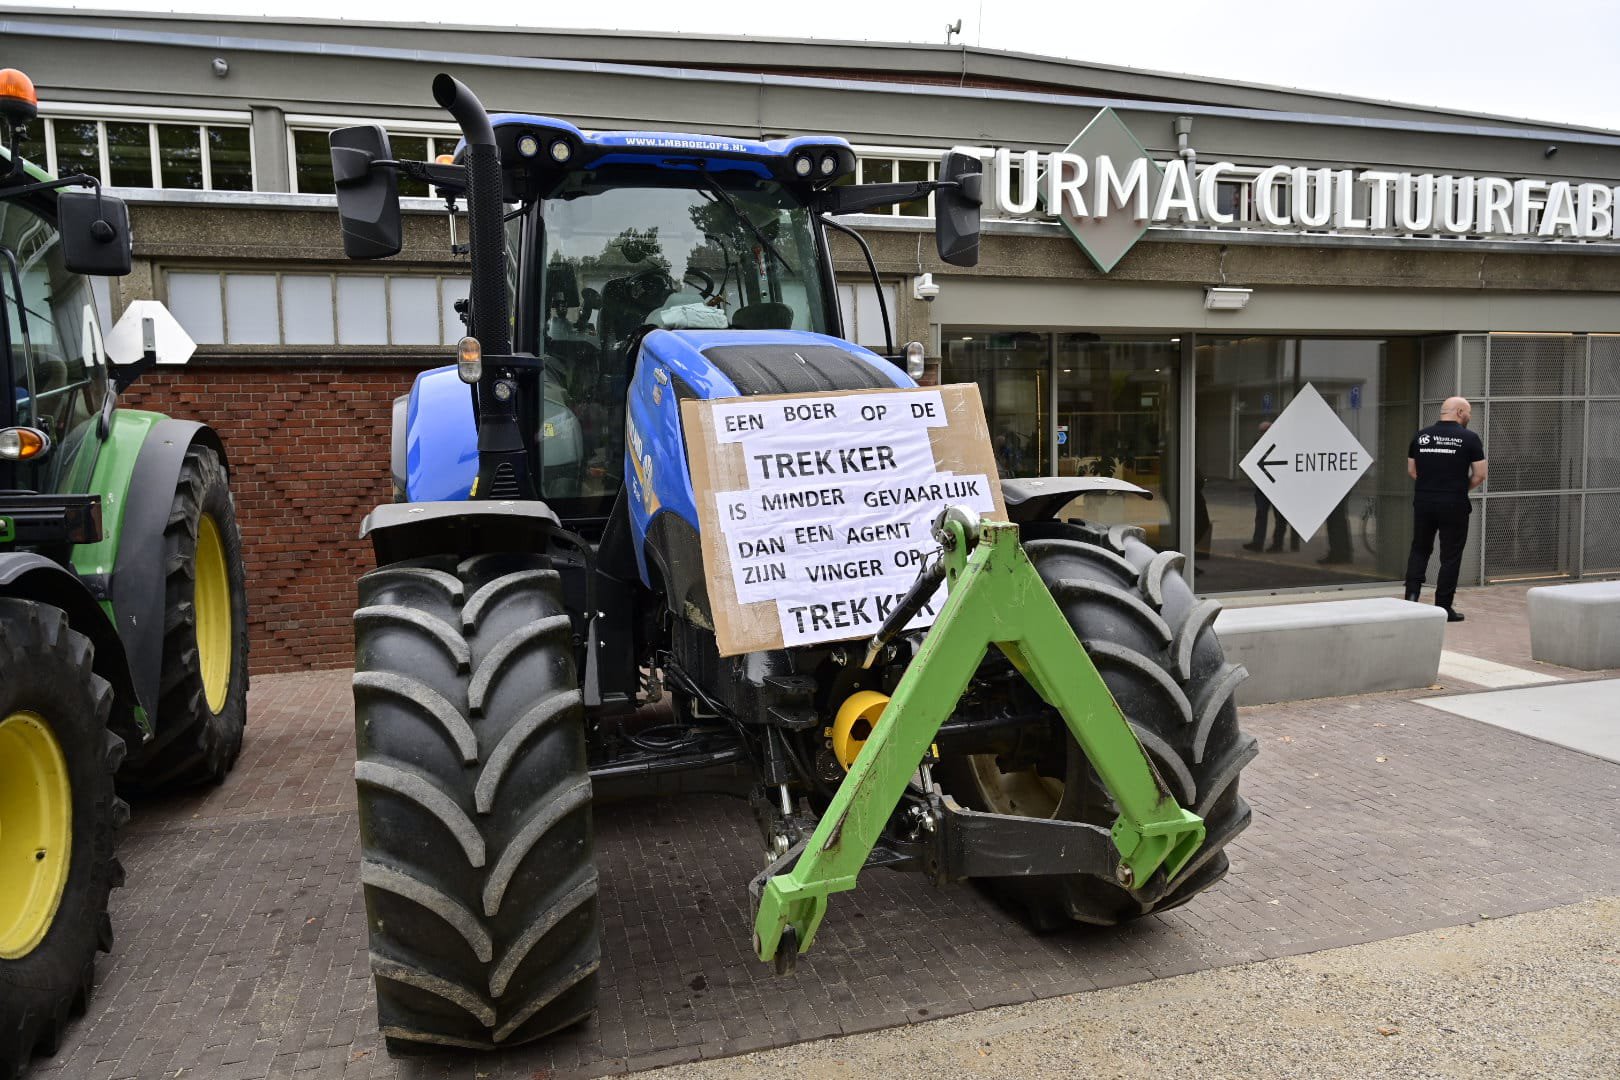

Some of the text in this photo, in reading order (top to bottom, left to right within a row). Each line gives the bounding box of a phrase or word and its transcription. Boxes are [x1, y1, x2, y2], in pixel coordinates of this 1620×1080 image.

[625, 138, 747, 152] WWW.LMBROELOFS.NL
[1255, 165, 1620, 237] CULTUURFAB
[725, 402, 936, 432] EEN BOER OP DE
[754, 445, 897, 480] TREKKER
[1296, 452, 1358, 473] ENTREE
[729, 480, 980, 521] IS MINDER GEVAARLIJK
[738, 522, 911, 559] DAN EEN AGENT
[742, 549, 921, 585] ZIJN VINGER OP
[788, 593, 935, 634] TREKK
